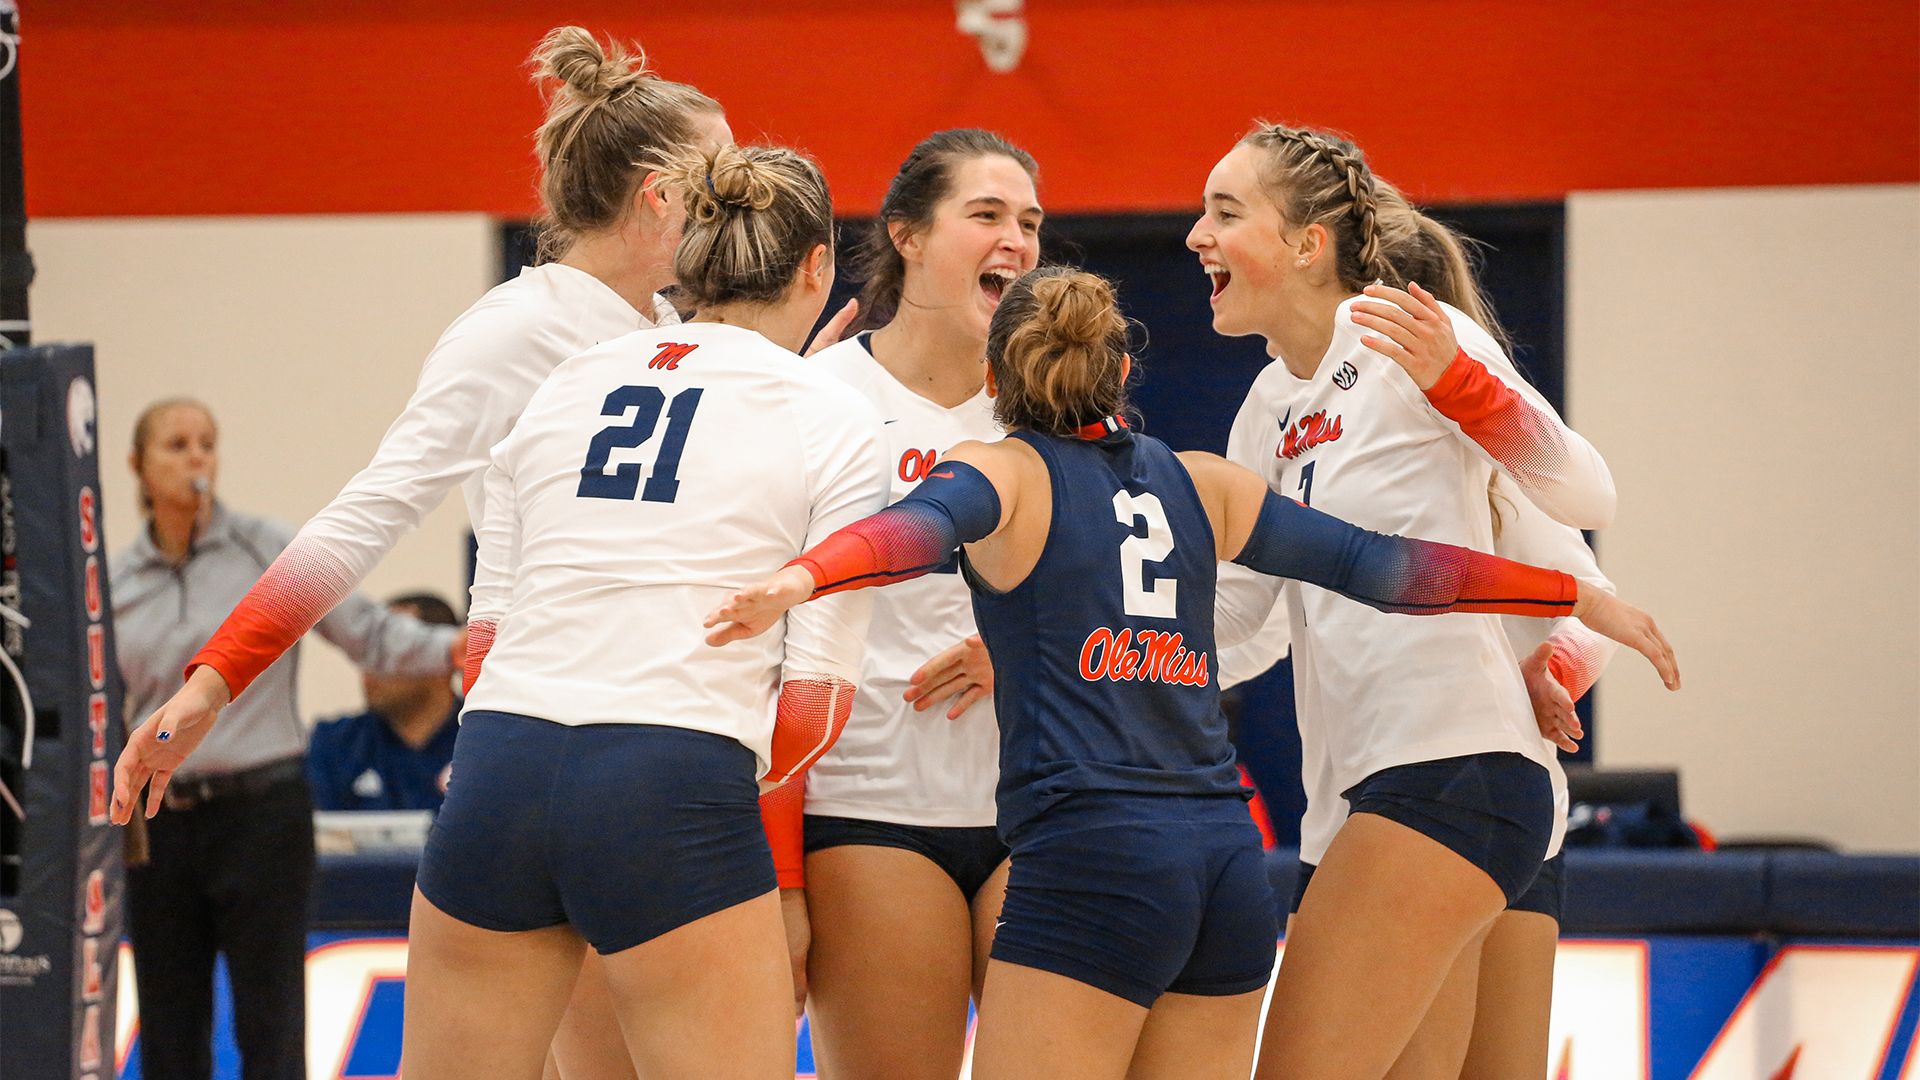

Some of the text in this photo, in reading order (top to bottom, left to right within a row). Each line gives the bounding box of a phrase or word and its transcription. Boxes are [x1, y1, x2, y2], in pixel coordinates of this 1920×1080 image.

[647, 341, 700, 371] M
[576, 385, 705, 504] 21
[898, 448, 937, 482] Ol
[1112, 489, 1178, 619] 2
[1079, 626, 1210, 688] Ole Miss
